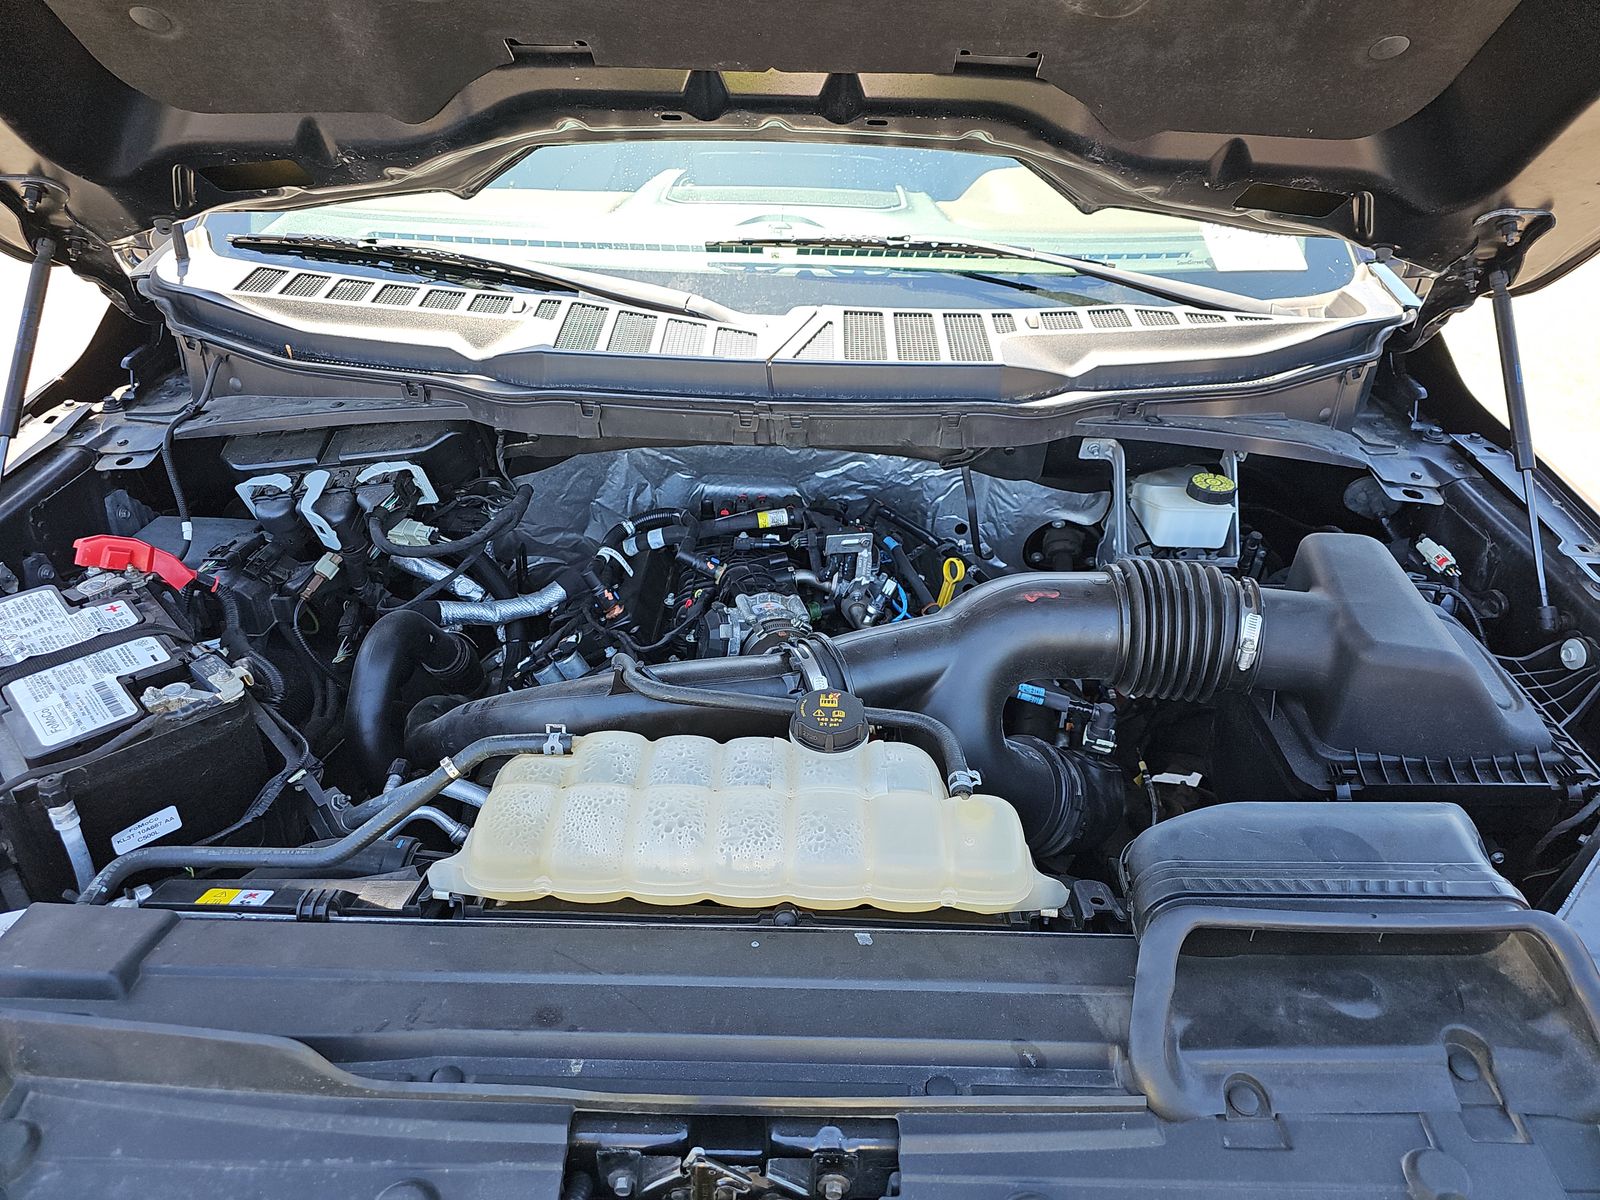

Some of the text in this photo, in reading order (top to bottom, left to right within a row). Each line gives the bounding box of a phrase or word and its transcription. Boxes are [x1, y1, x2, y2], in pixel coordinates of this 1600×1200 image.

[41, 707, 63, 733] FoMoCo
[116, 833, 136, 845] KL3T
[164, 816, 175, 824] AA
[128, 816, 160, 833] FoMoCo
[137, 830, 160, 843] C500L
